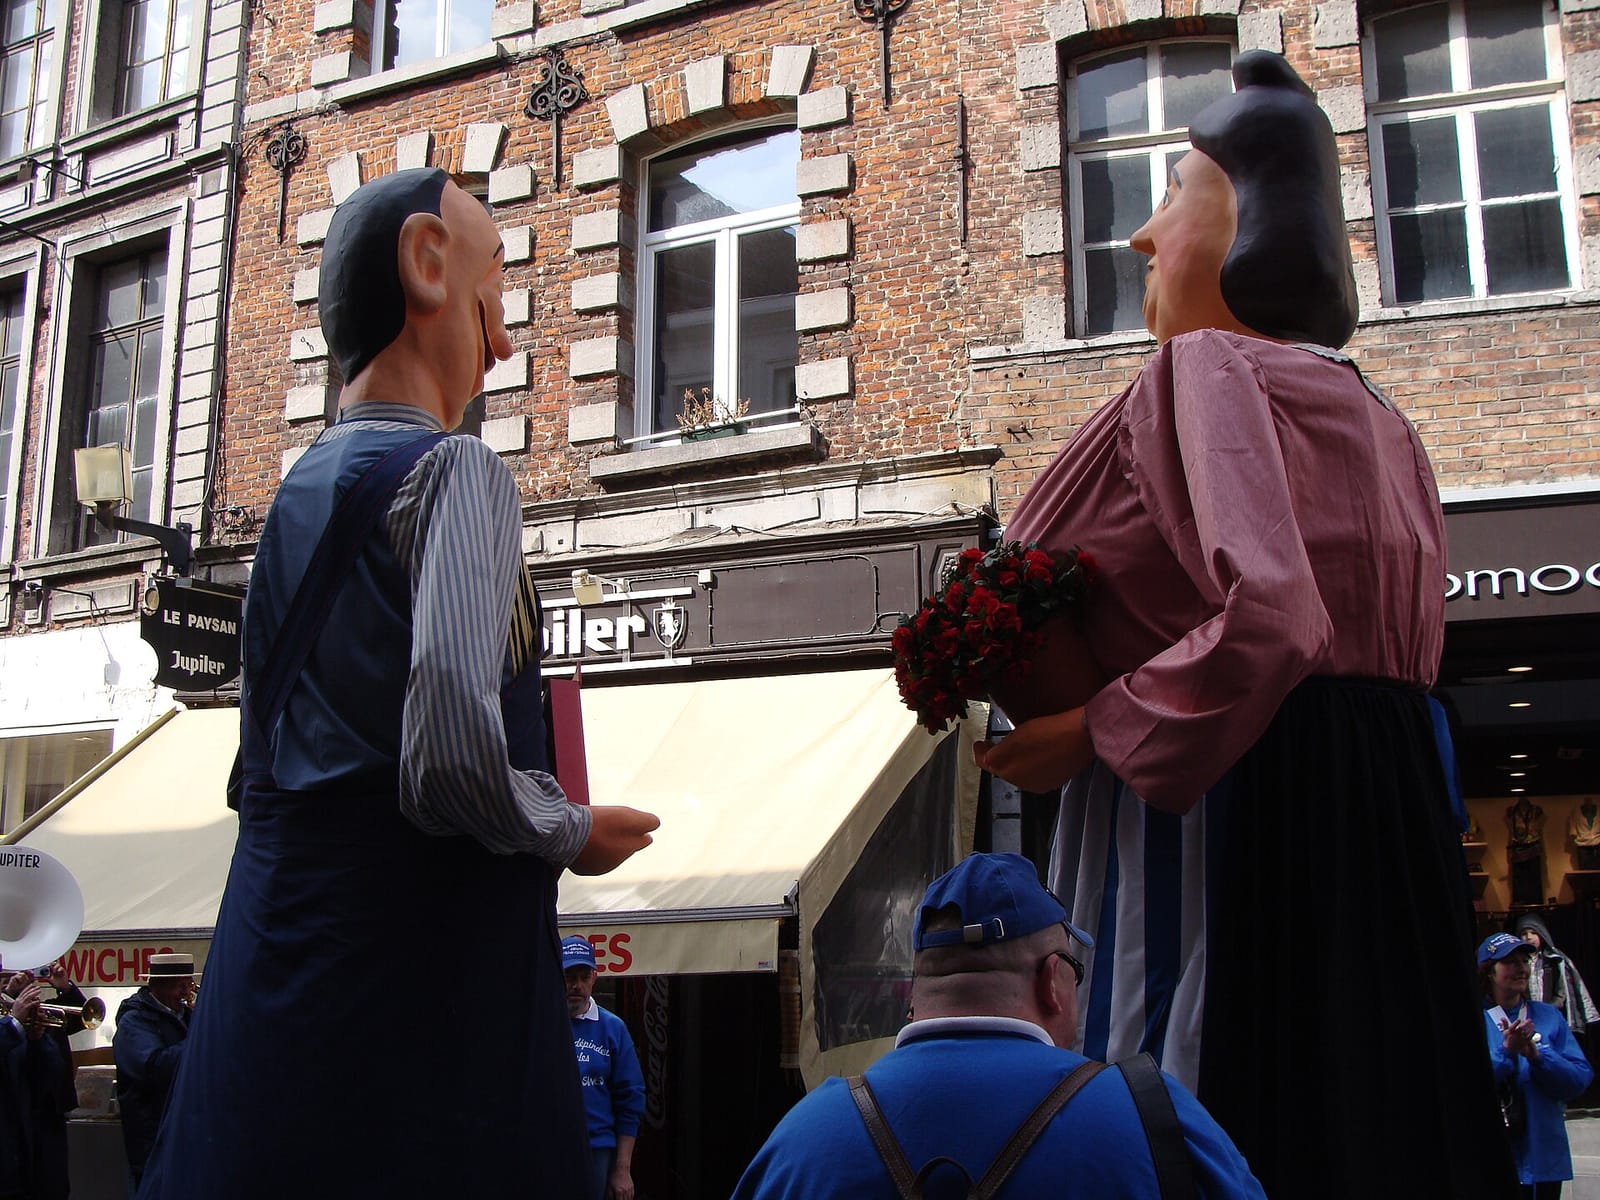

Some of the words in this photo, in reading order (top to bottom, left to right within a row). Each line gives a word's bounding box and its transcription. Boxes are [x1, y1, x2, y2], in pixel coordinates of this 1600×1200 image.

[1444, 562, 1600, 599] mo
[163, 609, 181, 626] LE
[187, 613, 237, 635] PAYSAN
[170, 650, 226, 677] Jupiler
[38, 947, 174, 983] WICHE
[570, 933, 633, 973] ES
